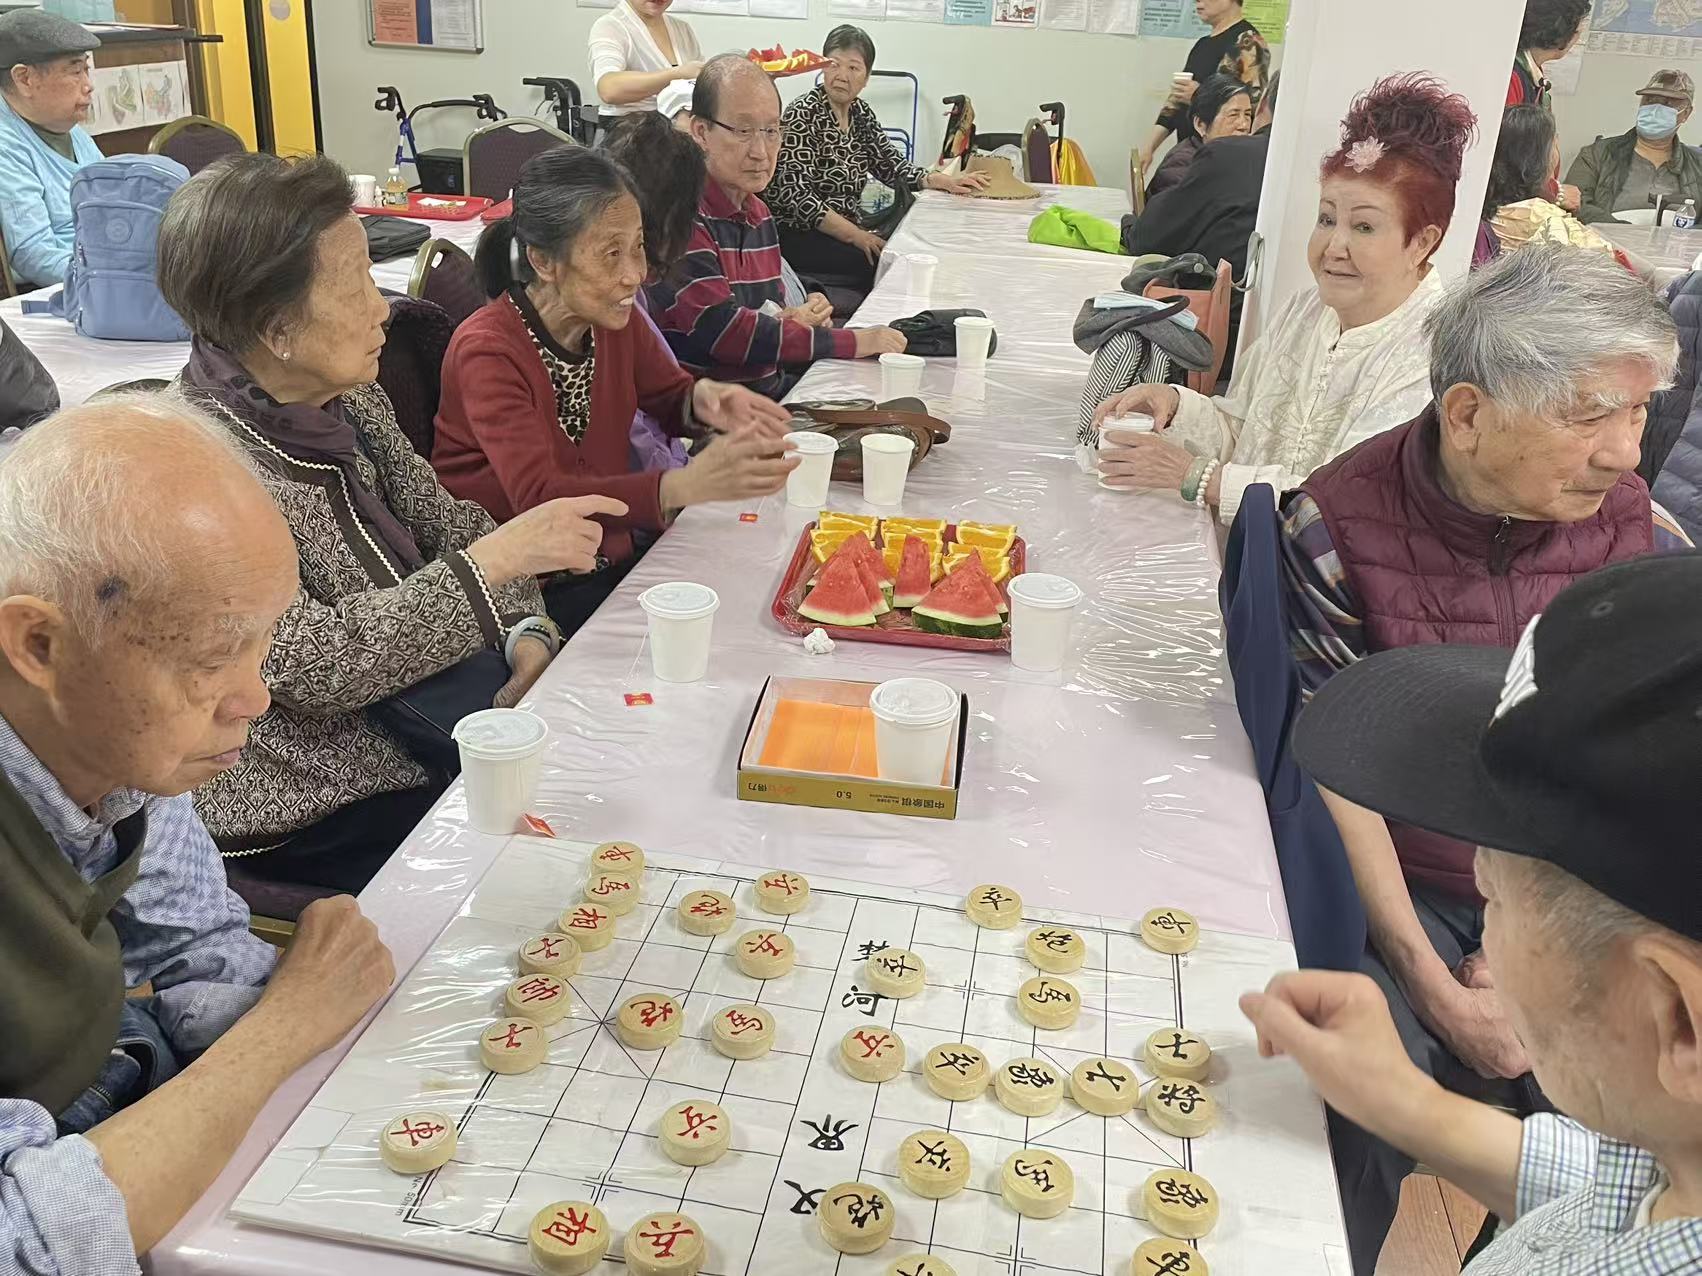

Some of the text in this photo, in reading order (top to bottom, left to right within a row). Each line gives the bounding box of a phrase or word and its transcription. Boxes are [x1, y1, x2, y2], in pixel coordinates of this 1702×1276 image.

[836, 790, 852, 799] 5.0
[901, 797, 945, 810] 中国象棋
[763, 873, 799, 896] 兵
[979, 887, 1013, 911] 卒
[568, 907, 607, 930] 相
[527, 937, 565, 960] 士
[745, 933, 784, 957] 兵
[876, 954, 918, 978] 卒
[489, 1023, 533, 1048] 士
[852, 1030, 895, 1058] 兵
[1154, 1033, 1199, 1060] 士
[935, 1051, 980, 1076] 卒
[1085, 1061, 1127, 1092] 士
[676, 1105, 718, 1139] 兵
[914, 1139, 951, 1172] 卒
[541, 1207, 597, 1247] 相
[639, 1220, 695, 1259] 兵
